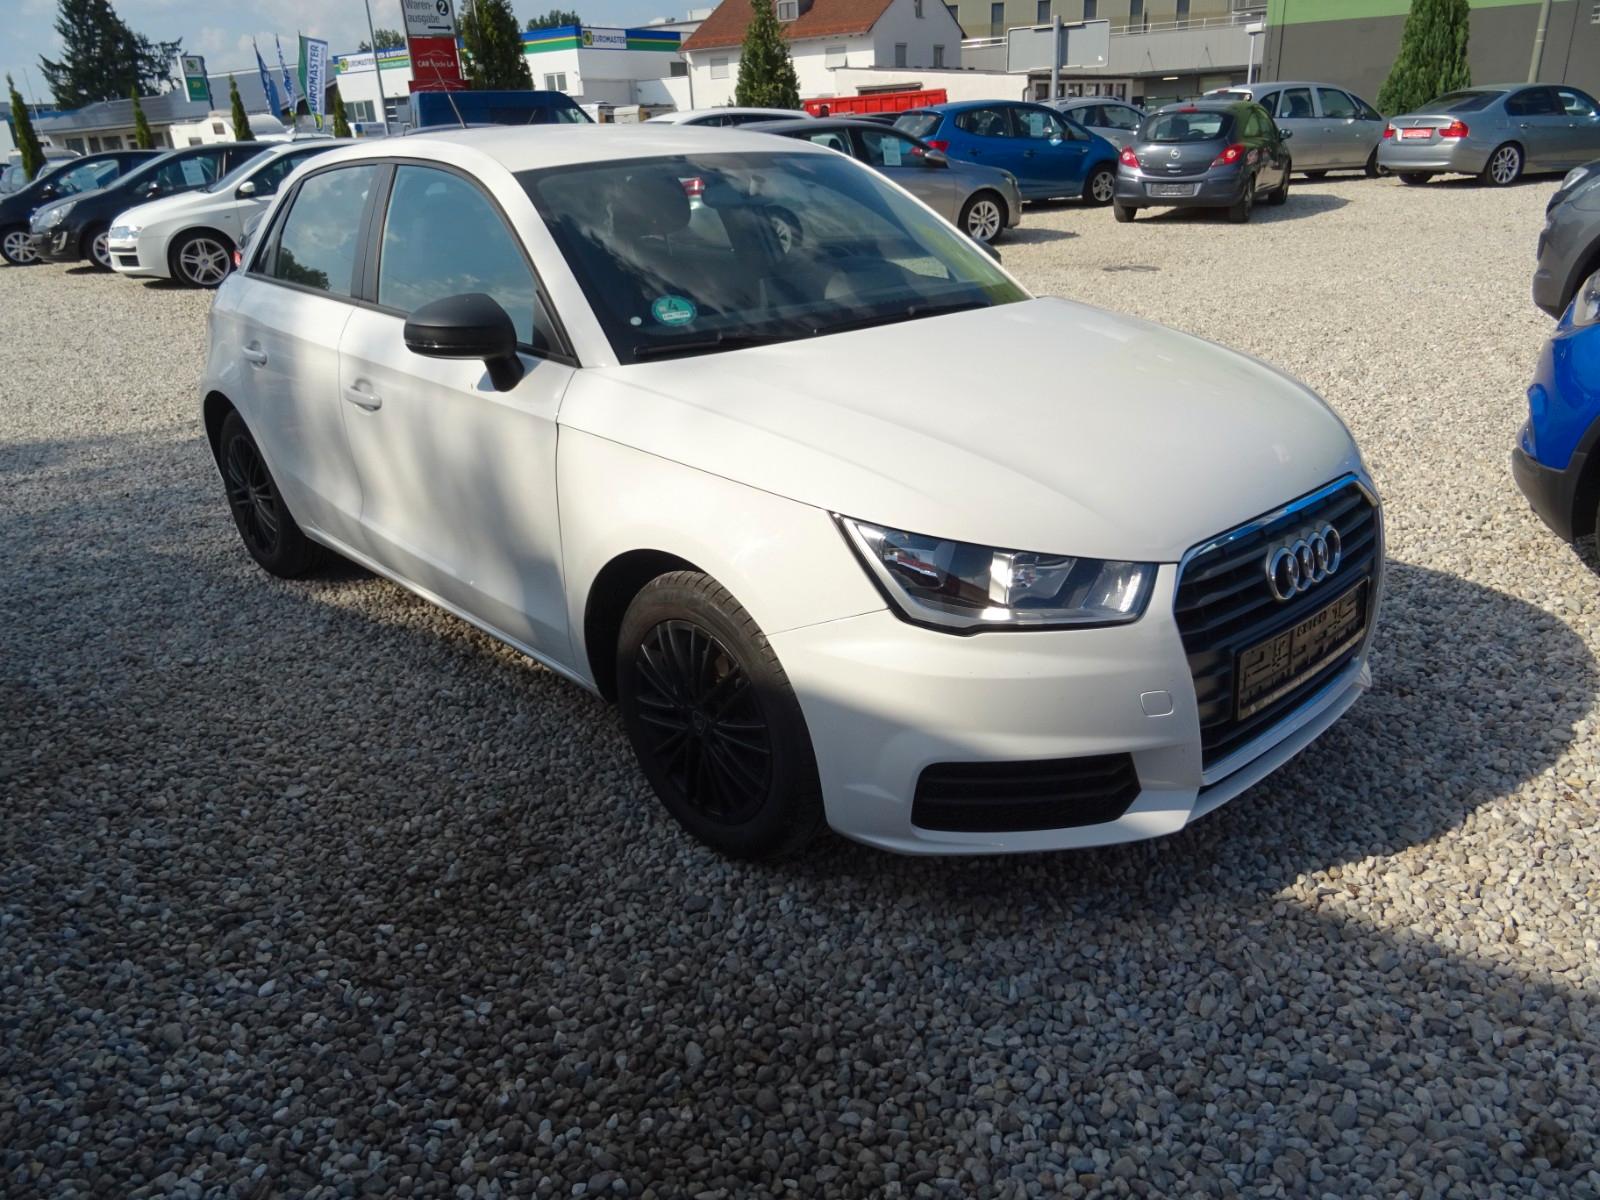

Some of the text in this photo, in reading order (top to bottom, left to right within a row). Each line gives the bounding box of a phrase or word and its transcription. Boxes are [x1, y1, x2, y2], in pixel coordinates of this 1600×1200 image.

[408, 13, 440, 25] ausgabe
[592, 34, 625, 44] EUROMASTER
[309, 44, 320, 113] EUROMASTER
